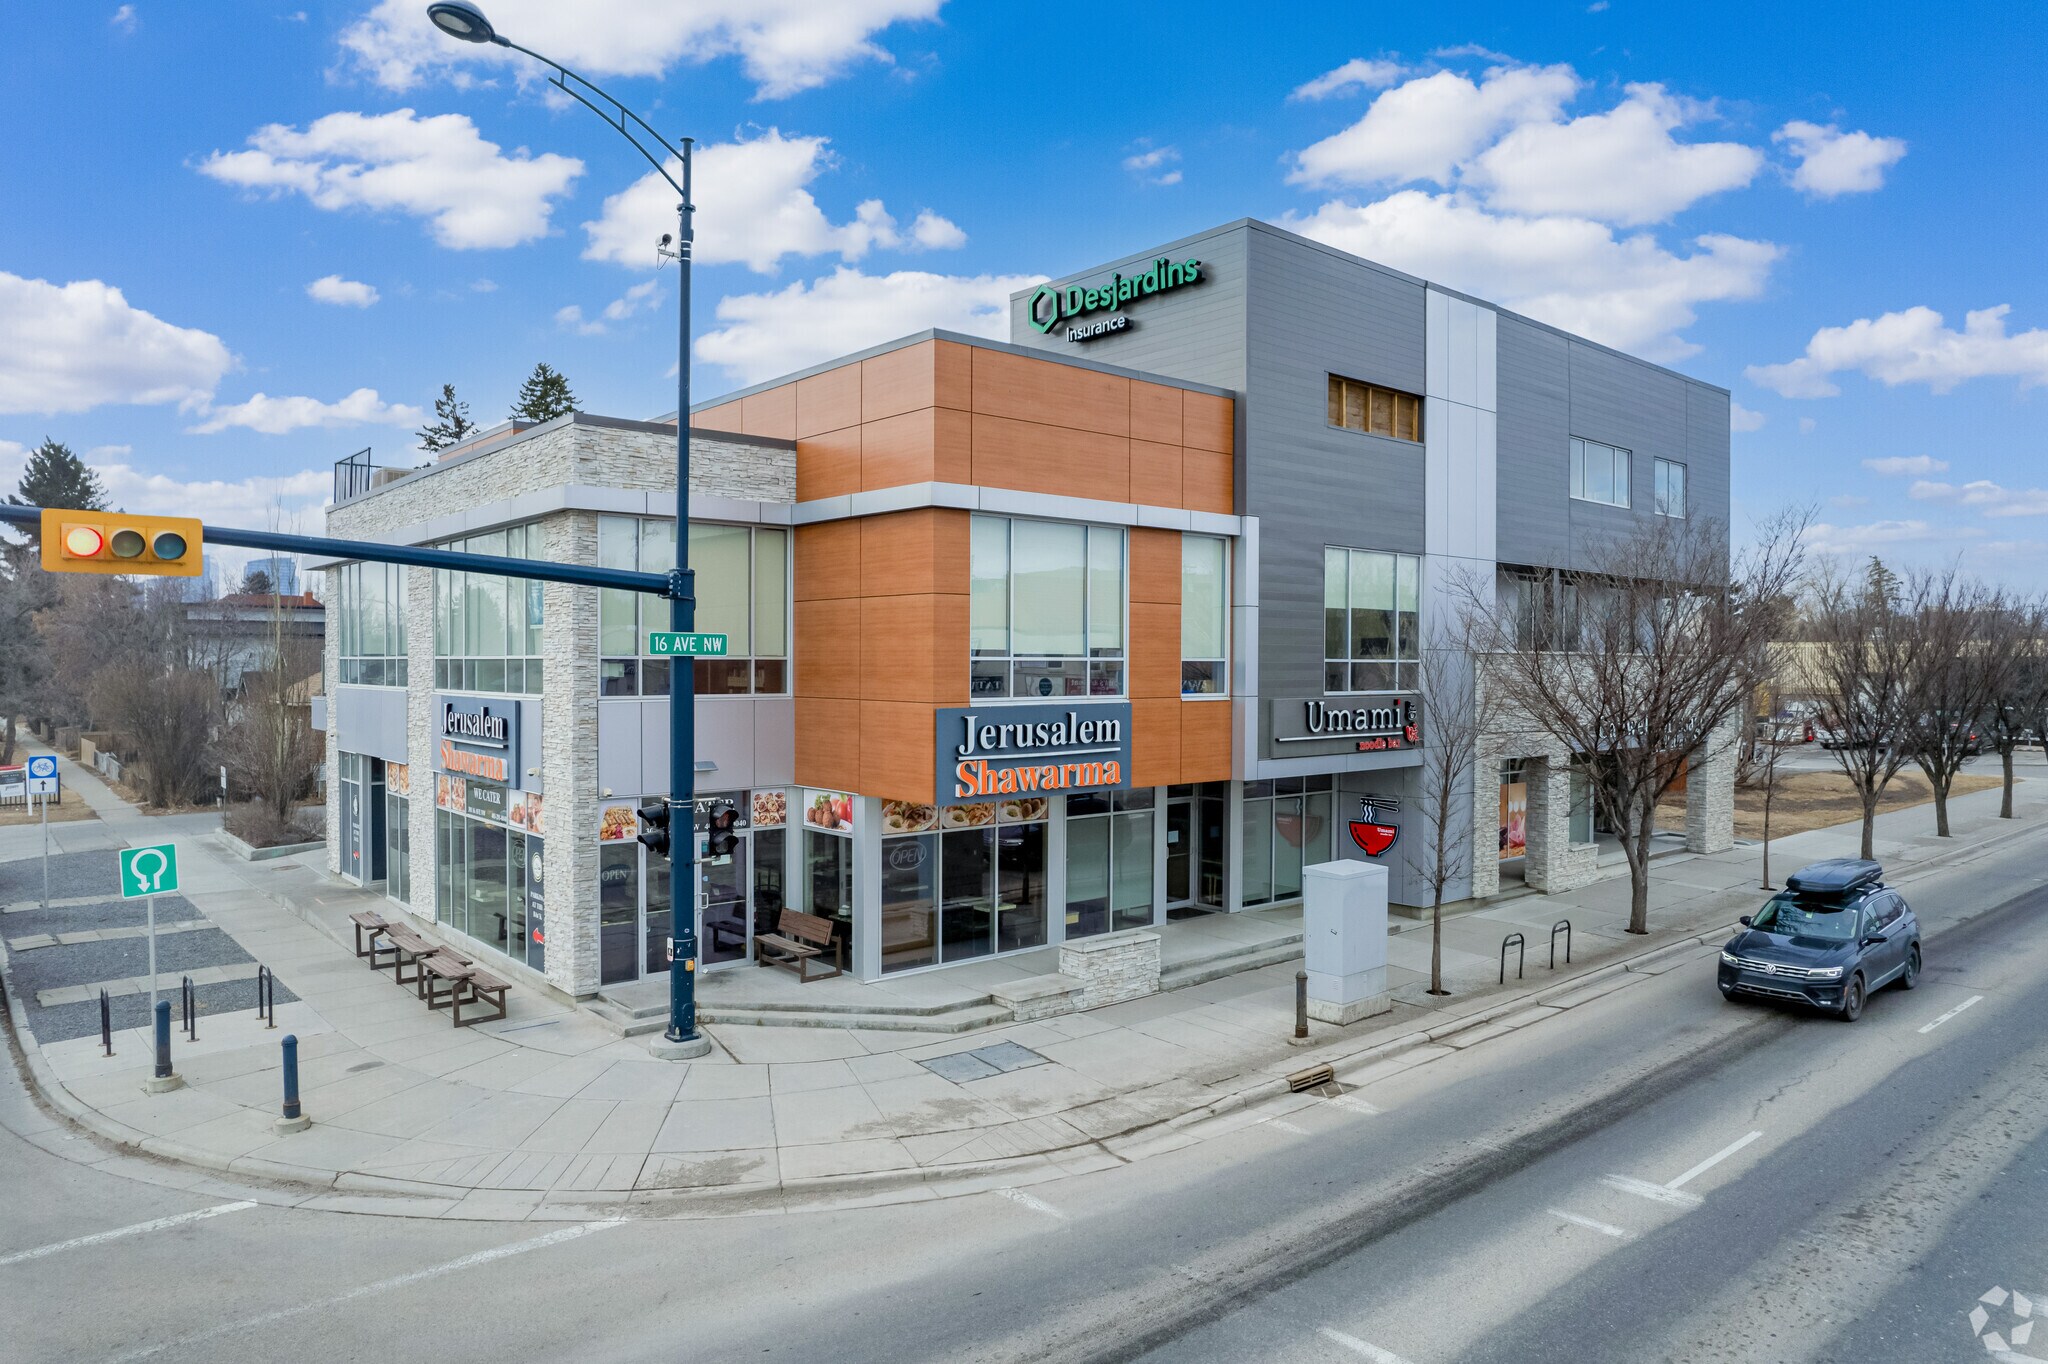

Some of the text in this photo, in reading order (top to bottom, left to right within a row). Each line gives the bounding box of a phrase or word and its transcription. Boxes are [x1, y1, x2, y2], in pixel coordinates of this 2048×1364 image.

[1066, 257, 1199, 316] Desjardins
[1066, 315, 1126, 342] Insurance
[655, 636, 723, 652] 16 AVE NW
[441, 703, 505, 740] Jerusalem
[957, 711, 1121, 755] Jerusalem
[1307, 699, 1402, 733] Umami
[440, 740, 505, 781] Shawarma
[473, 787, 501, 804] WE CATER
[955, 760, 1122, 798] Shawarma
[892, 847, 924, 865] OPEN
[601, 869, 627, 881] OPEN
